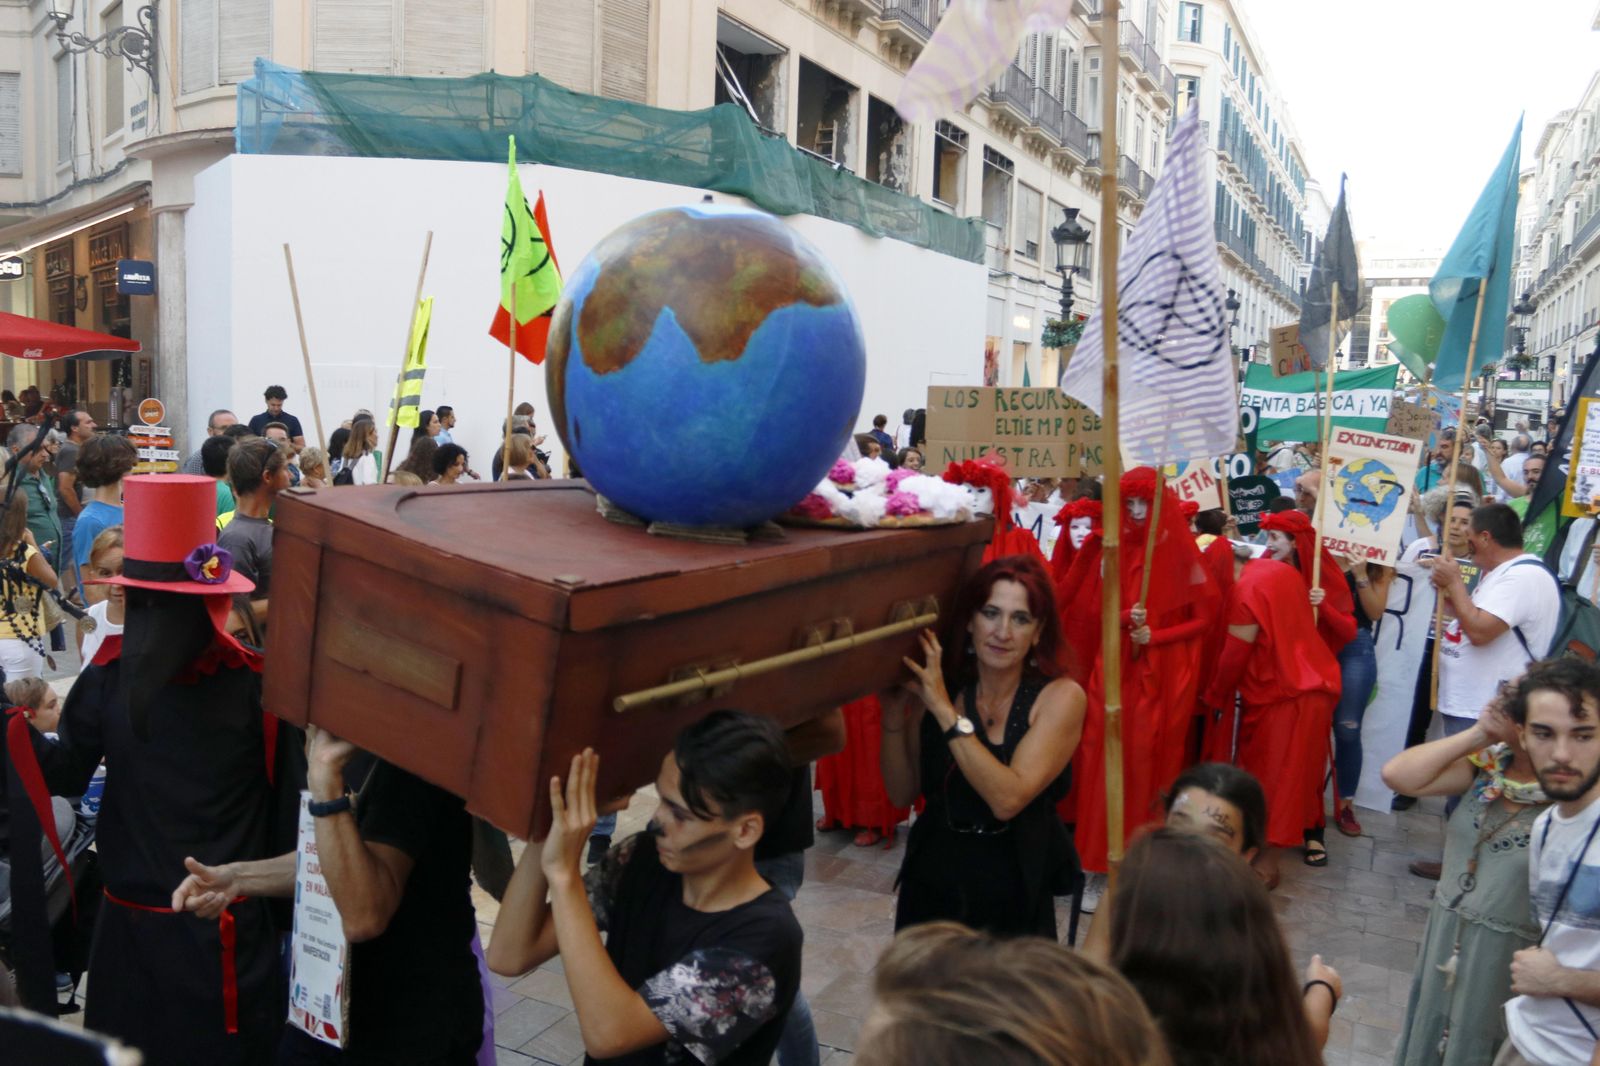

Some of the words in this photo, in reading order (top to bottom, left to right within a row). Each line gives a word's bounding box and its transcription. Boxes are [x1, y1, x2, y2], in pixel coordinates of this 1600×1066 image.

[944, 389, 979, 408] LOS
[995, 388, 1088, 412] RECURSO
[1240, 393, 1291, 412] RENTA
[1296, 393, 1355, 413] BÁSCA
[1370, 394, 1389, 412] YA
[1082, 414, 1103, 432] SE
[1336, 431, 1416, 455] EXTINCTION
